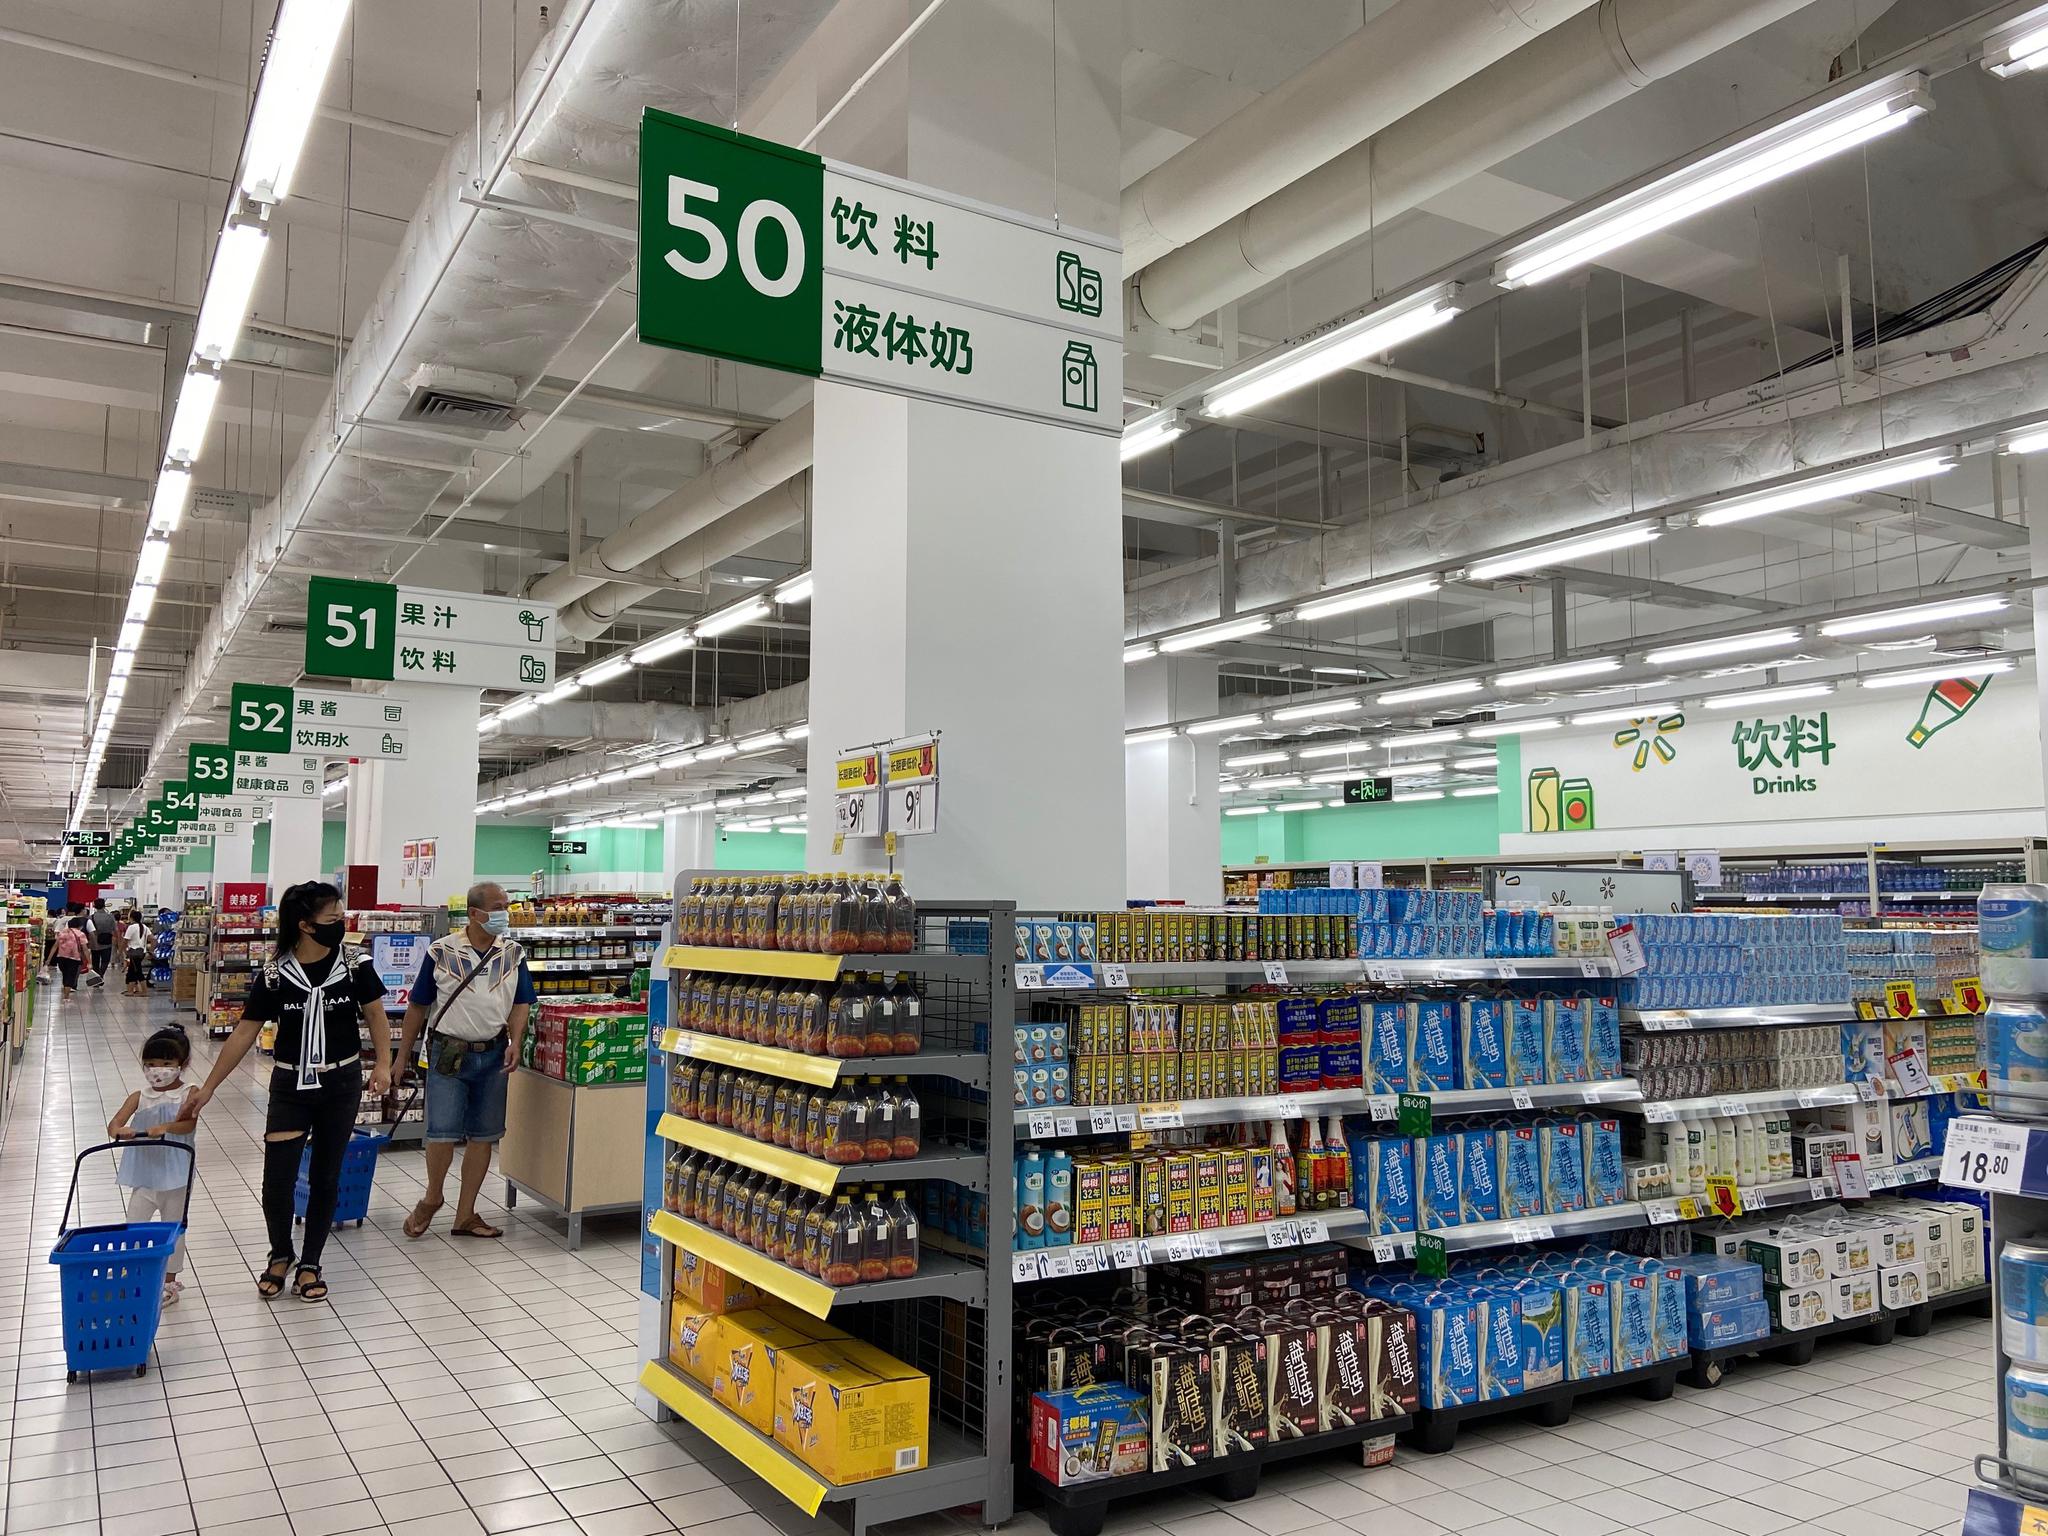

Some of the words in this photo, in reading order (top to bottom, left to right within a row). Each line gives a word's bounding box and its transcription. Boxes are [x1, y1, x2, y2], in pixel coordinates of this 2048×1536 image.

[664, 174, 806, 298] 50
[830, 195, 940, 271] 饮料
[833, 299, 973, 375] 液体奶
[325, 603, 377, 650] 51
[400, 602, 458, 629] 果汁
[400, 646, 457, 674] 饮料
[238, 701, 286, 733] 52
[296, 699, 338, 717] 果酱
[296, 729, 349, 748] 饮用水
[1731, 711, 1837, 772] 饮料
[193, 756, 229, 780] 53
[237, 754, 269, 767] 果酱
[236, 777, 289, 792] 健康食品
[1753, 774, 1817, 795] Drinks
[166, 791, 197, 810] 54
[199, 807, 243, 818] 冲调食品
[150, 809, 175, 825] 5
[136, 824, 158, 838] 5
[396, 988, 412, 1005] 2
[1380, 1010, 1403, 1068] 維他奶
[1425, 1008, 1449, 1066] 維他奶
[1478, 1007, 1500, 1063] 維他奶
[1402, 1096, 1428, 1110] 省心价
[1032, 1121, 1051, 1135] 16.80
[1092, 1117, 1111, 1131] 19.80
[1228, 1174, 1245, 1184] 32年
[1387, 1146, 1409, 1206] 維他奶
[1432, 1142, 1456, 1201] 維他奶
[1470, 1138, 1493, 1197] 維他奶
[1960, 1150, 2009, 1184] 18.80
[1082, 1188, 1101, 1199] 32年
[1110, 1184, 1130, 1196] 32年
[1171, 1180, 1189, 1191] 32年
[1200, 1176, 1217, 1187] 32年
[1419, 1235, 1443, 1251] 省心价
[1075, 1258, 1095, 1273] 59.00
[1451, 1313, 1473, 1377] 維他奶
[1496, 1305, 1519, 1368] 維他奶
[1337, 1329, 1365, 1396] 維他奶
[1389, 1321, 1415, 1386] 維他奶
[1235, 1349, 1265, 1419] 維他奶
[1287, 1338, 1315, 1407] 維他奶
[1178, 1360, 1207, 1433] 維他奶
